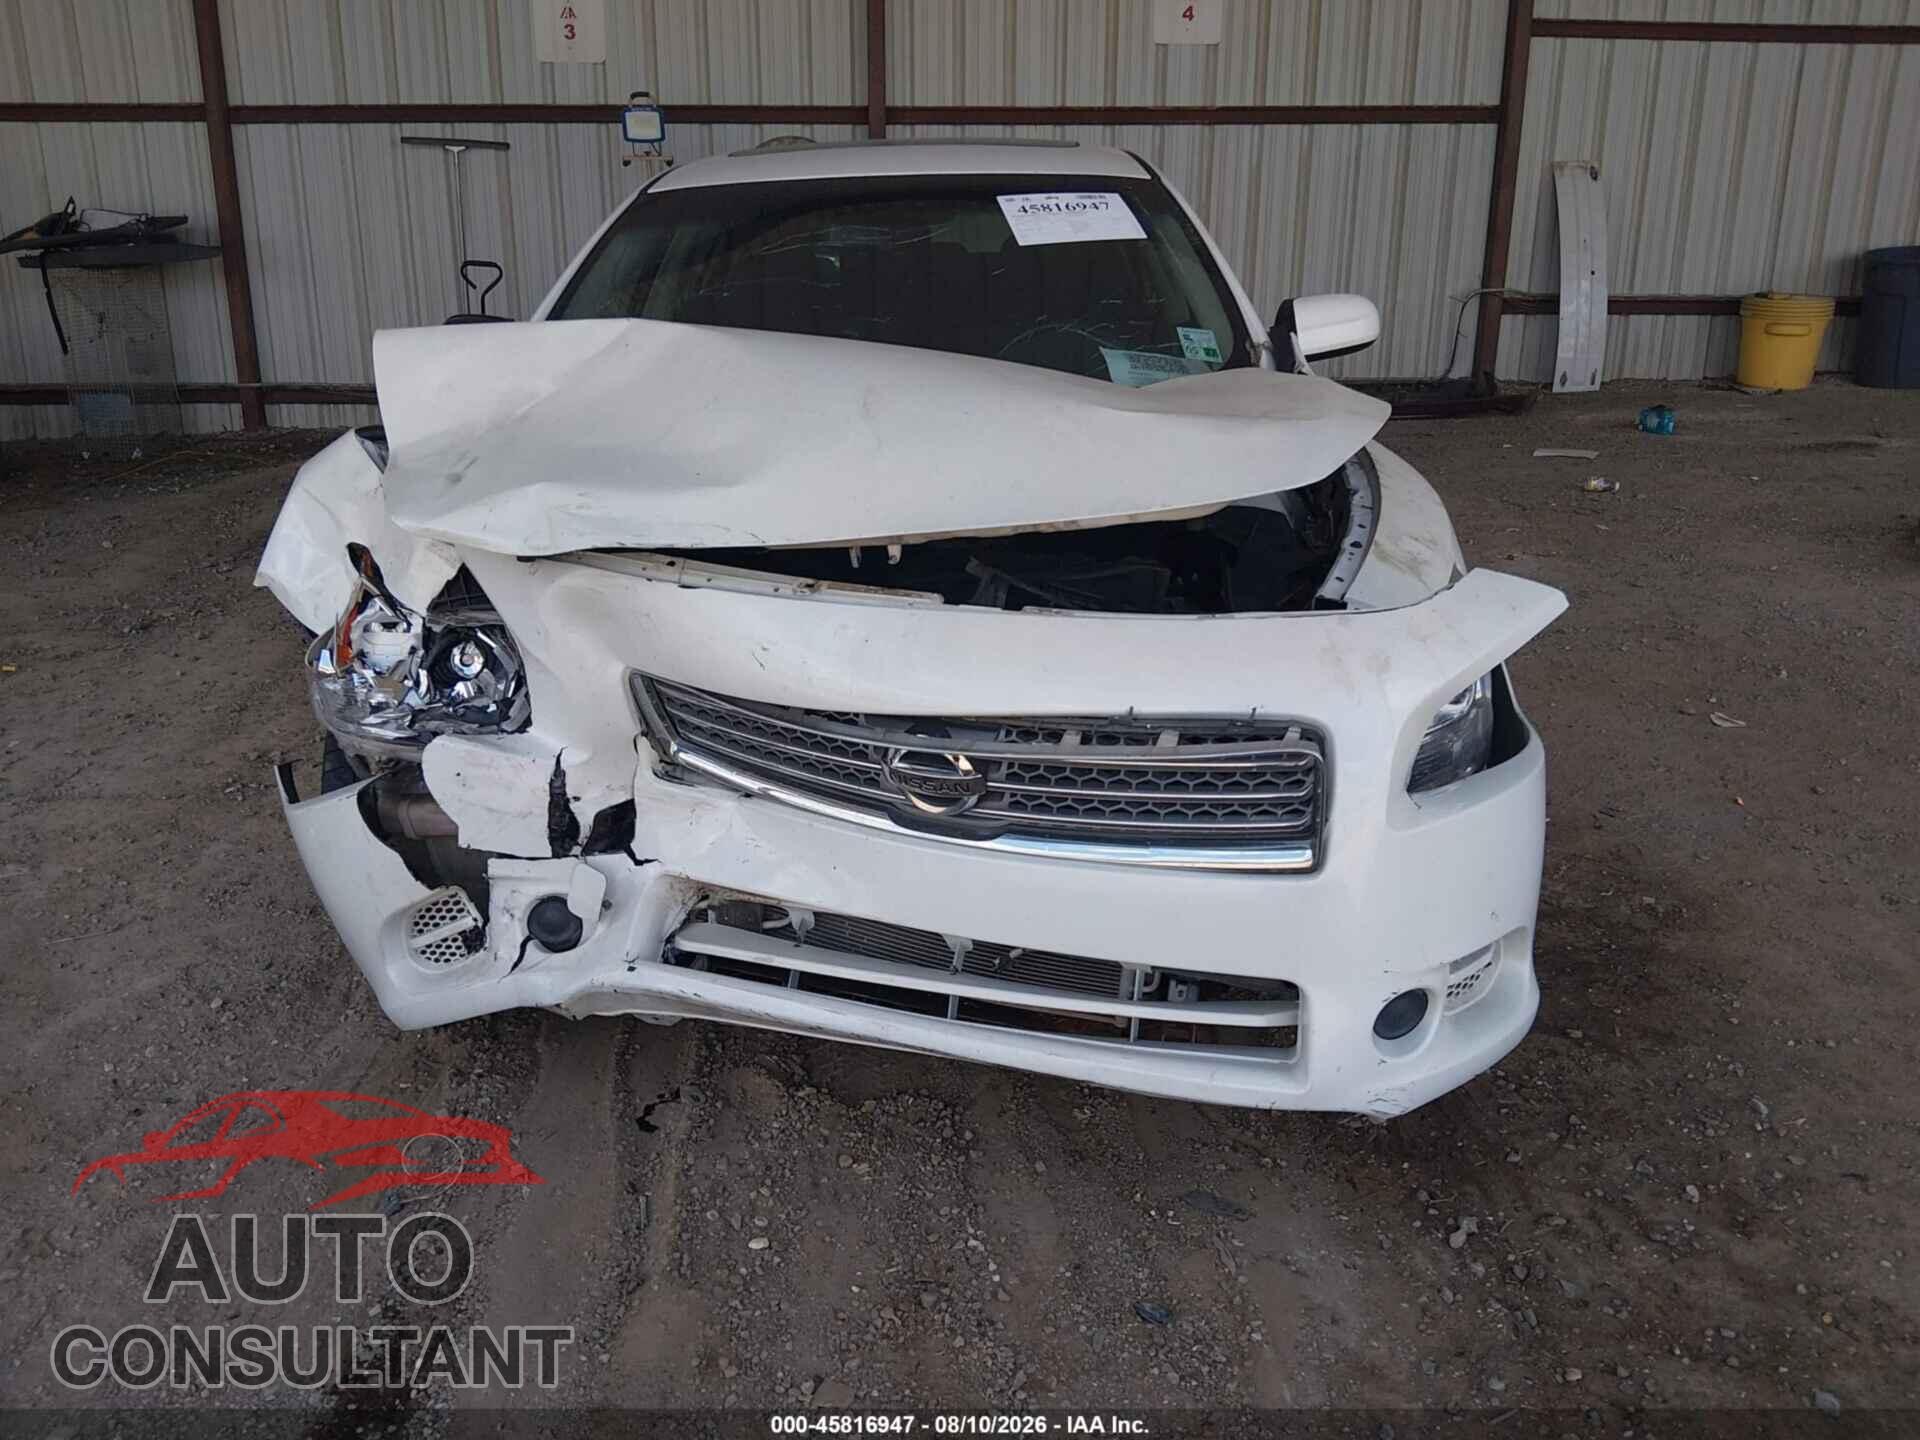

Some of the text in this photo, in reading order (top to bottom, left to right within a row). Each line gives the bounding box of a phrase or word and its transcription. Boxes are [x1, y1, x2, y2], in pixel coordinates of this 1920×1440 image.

[1182, 6, 1194, 21] 4
[564, 24, 577, 40] 3
[1017, 201, 1110, 215] 45816947
